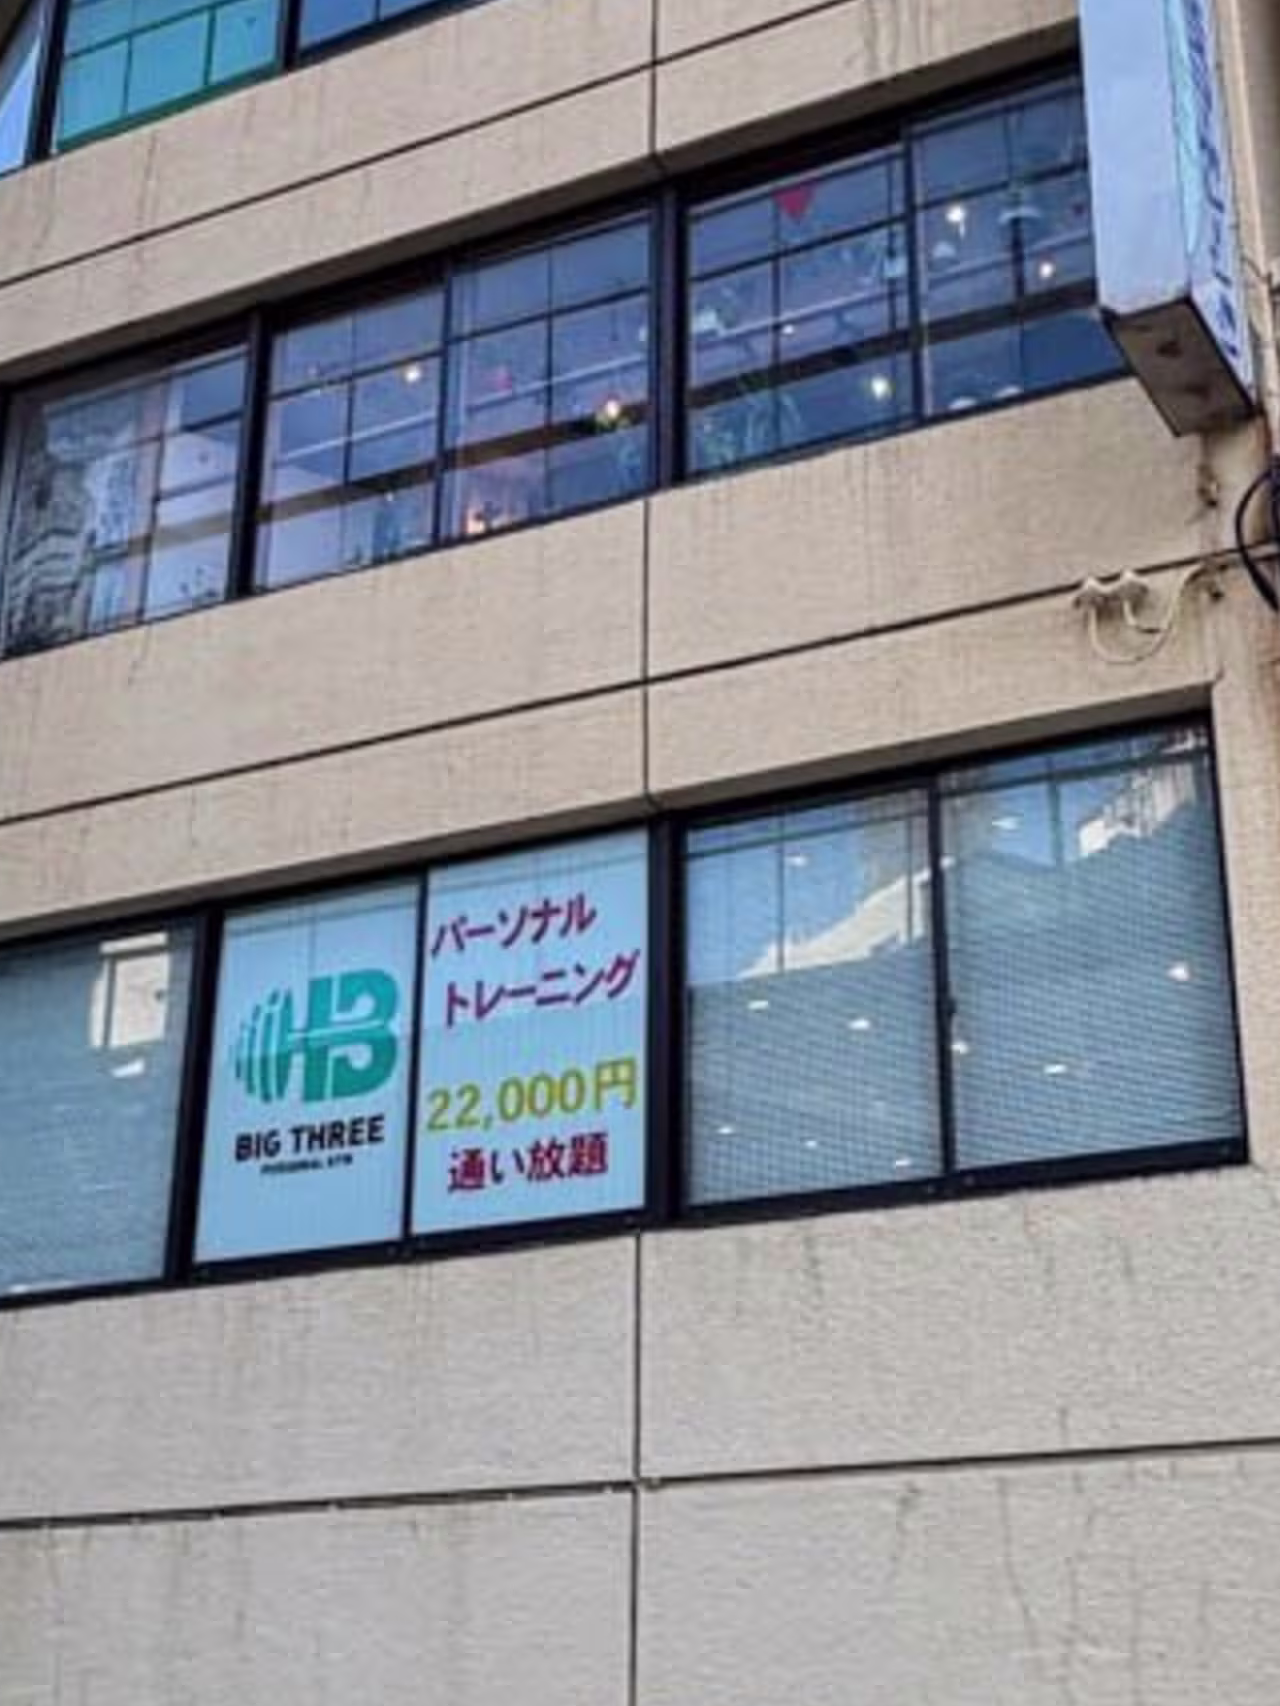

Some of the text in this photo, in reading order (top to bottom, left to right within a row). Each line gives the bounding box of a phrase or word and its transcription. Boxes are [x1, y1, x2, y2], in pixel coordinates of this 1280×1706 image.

[431, 891, 597, 957] パーソナル
[446, 948, 640, 1028] トレーニング
[426, 1056, 637, 1132] 22,000円
[234, 1113, 386, 1162] BIG THREE
[447, 1131, 609, 1194] 通い放題
